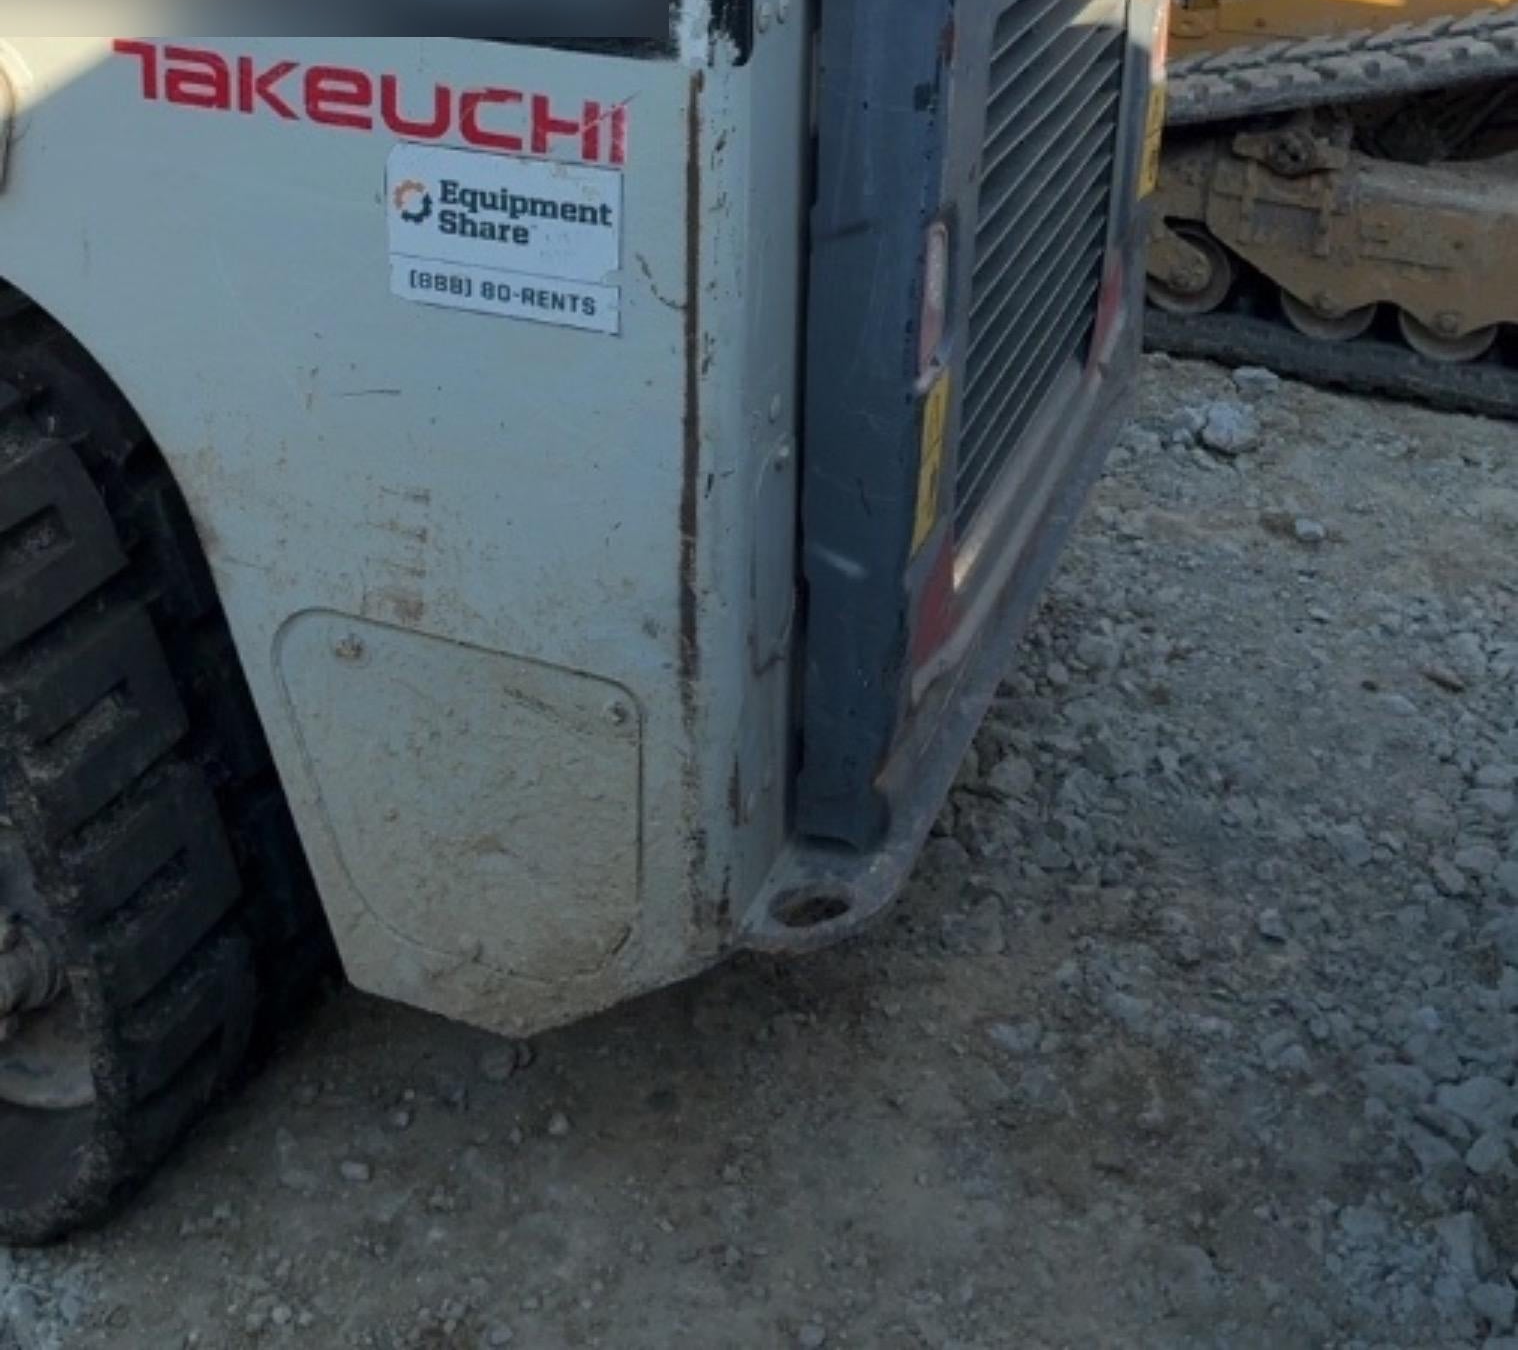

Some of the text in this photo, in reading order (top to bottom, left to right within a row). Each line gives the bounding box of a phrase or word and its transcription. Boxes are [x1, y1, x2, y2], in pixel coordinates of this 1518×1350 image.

[438, 178, 613, 227] Equipment
[437, 209, 530, 244] Share
[480, 281, 596, 317] 80-RENTS
